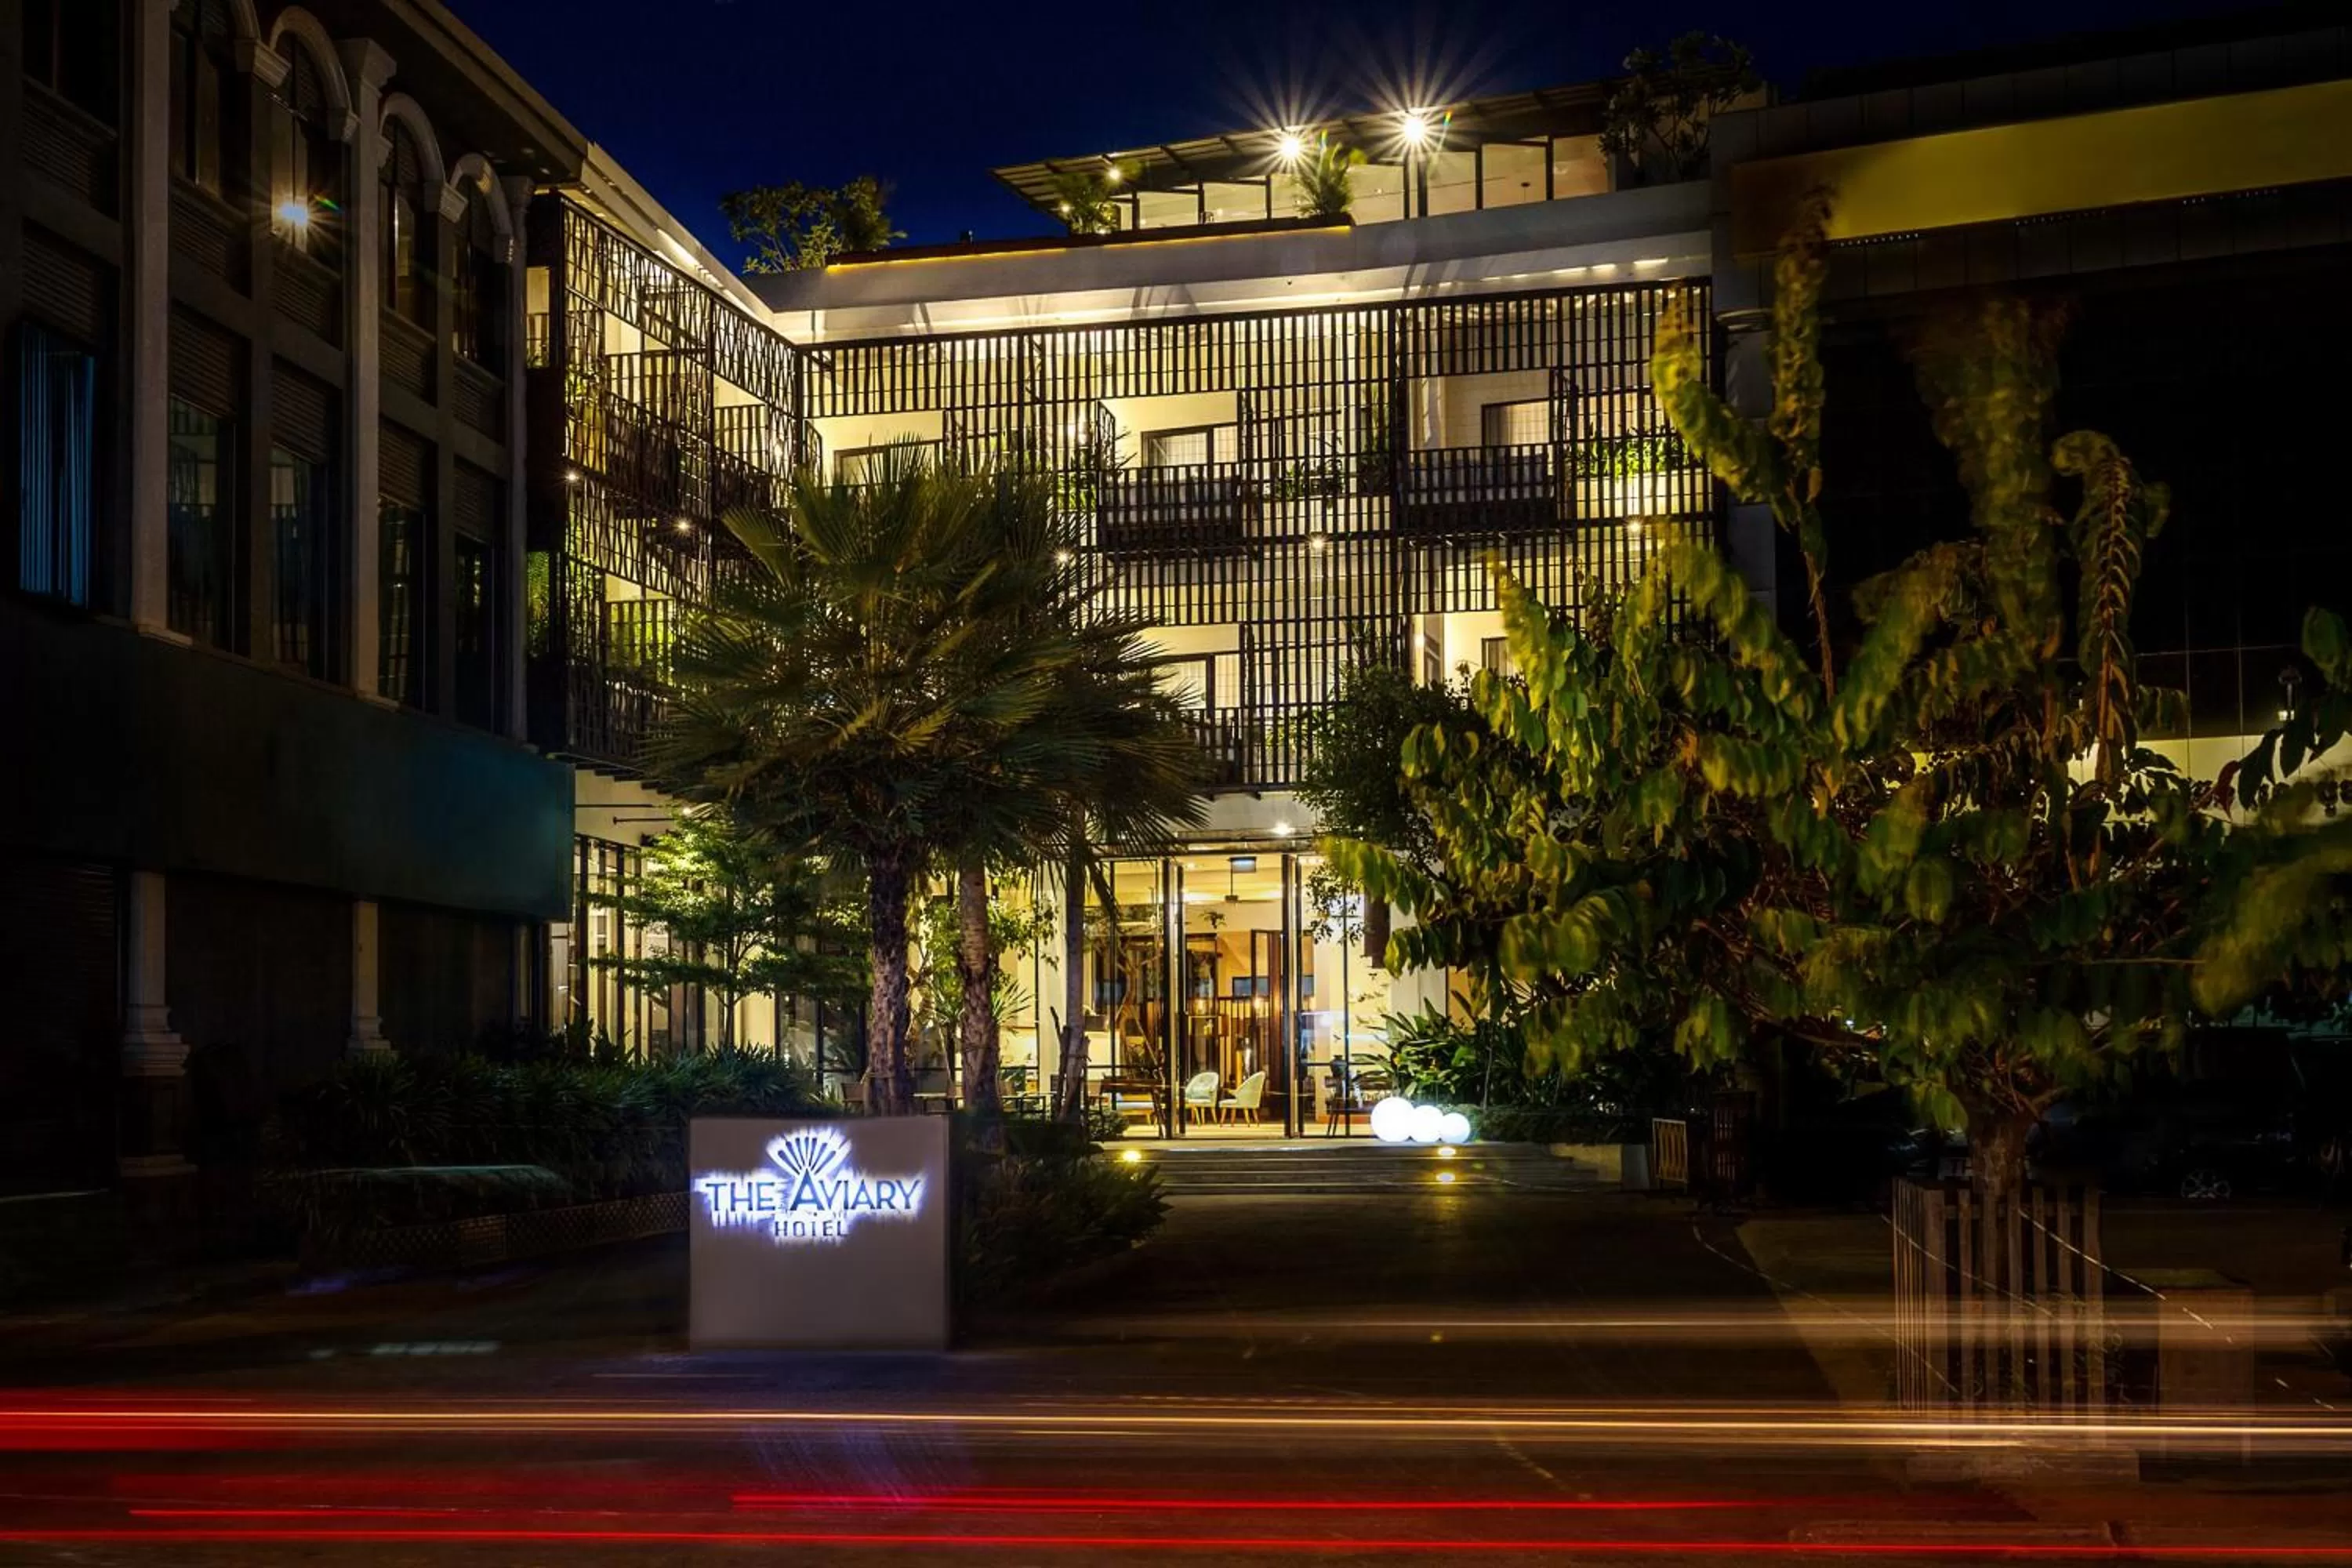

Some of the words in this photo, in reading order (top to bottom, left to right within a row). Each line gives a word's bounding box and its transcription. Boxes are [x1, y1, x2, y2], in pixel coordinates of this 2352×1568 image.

[705, 1182, 775, 1211] THE
[789, 1168, 920, 1210] AVIARY
[774, 1220, 849, 1237] HOTEL
